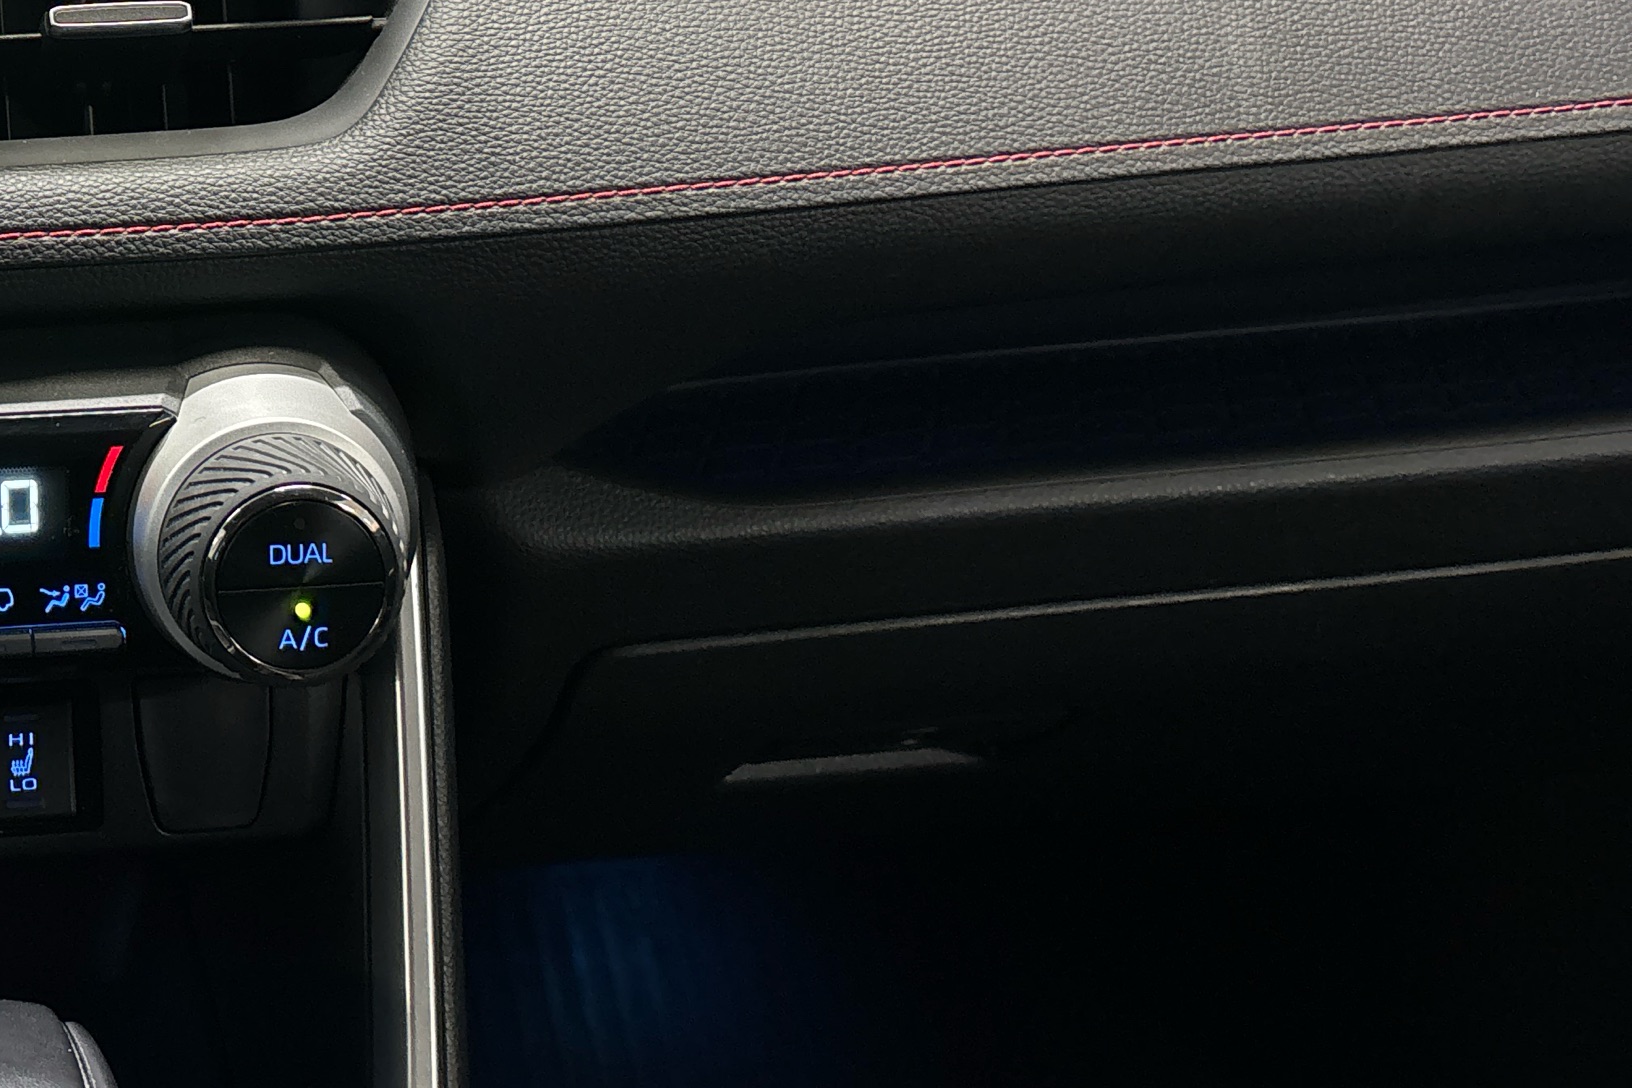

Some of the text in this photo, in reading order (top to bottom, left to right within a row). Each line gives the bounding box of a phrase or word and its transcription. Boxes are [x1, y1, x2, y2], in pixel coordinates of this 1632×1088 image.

[269, 542, 333, 565] DUAL
[278, 625, 328, 652] A/C
[8, 732, 34, 745] HI
[9, 777, 38, 792] LO
